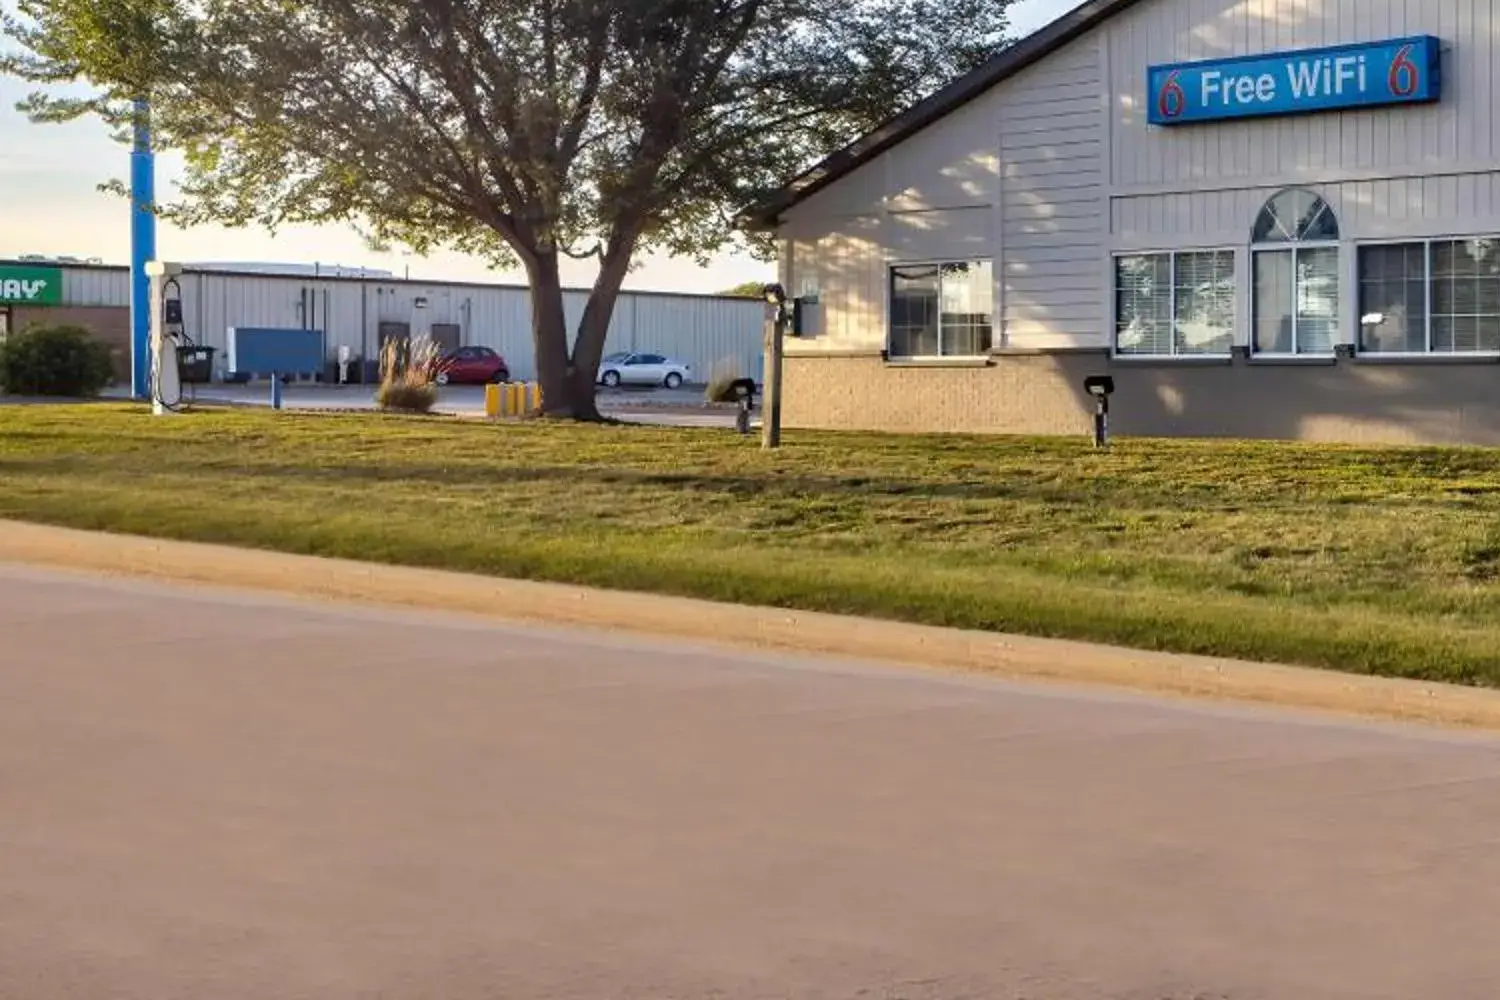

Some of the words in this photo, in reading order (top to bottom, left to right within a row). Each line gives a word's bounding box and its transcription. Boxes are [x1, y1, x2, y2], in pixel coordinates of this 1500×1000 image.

[1158, 68, 1185, 118] 6
[1201, 71, 1277, 106] Free
[1287, 54, 1367, 98] WiFi
[1388, 44, 1418, 98] 6
